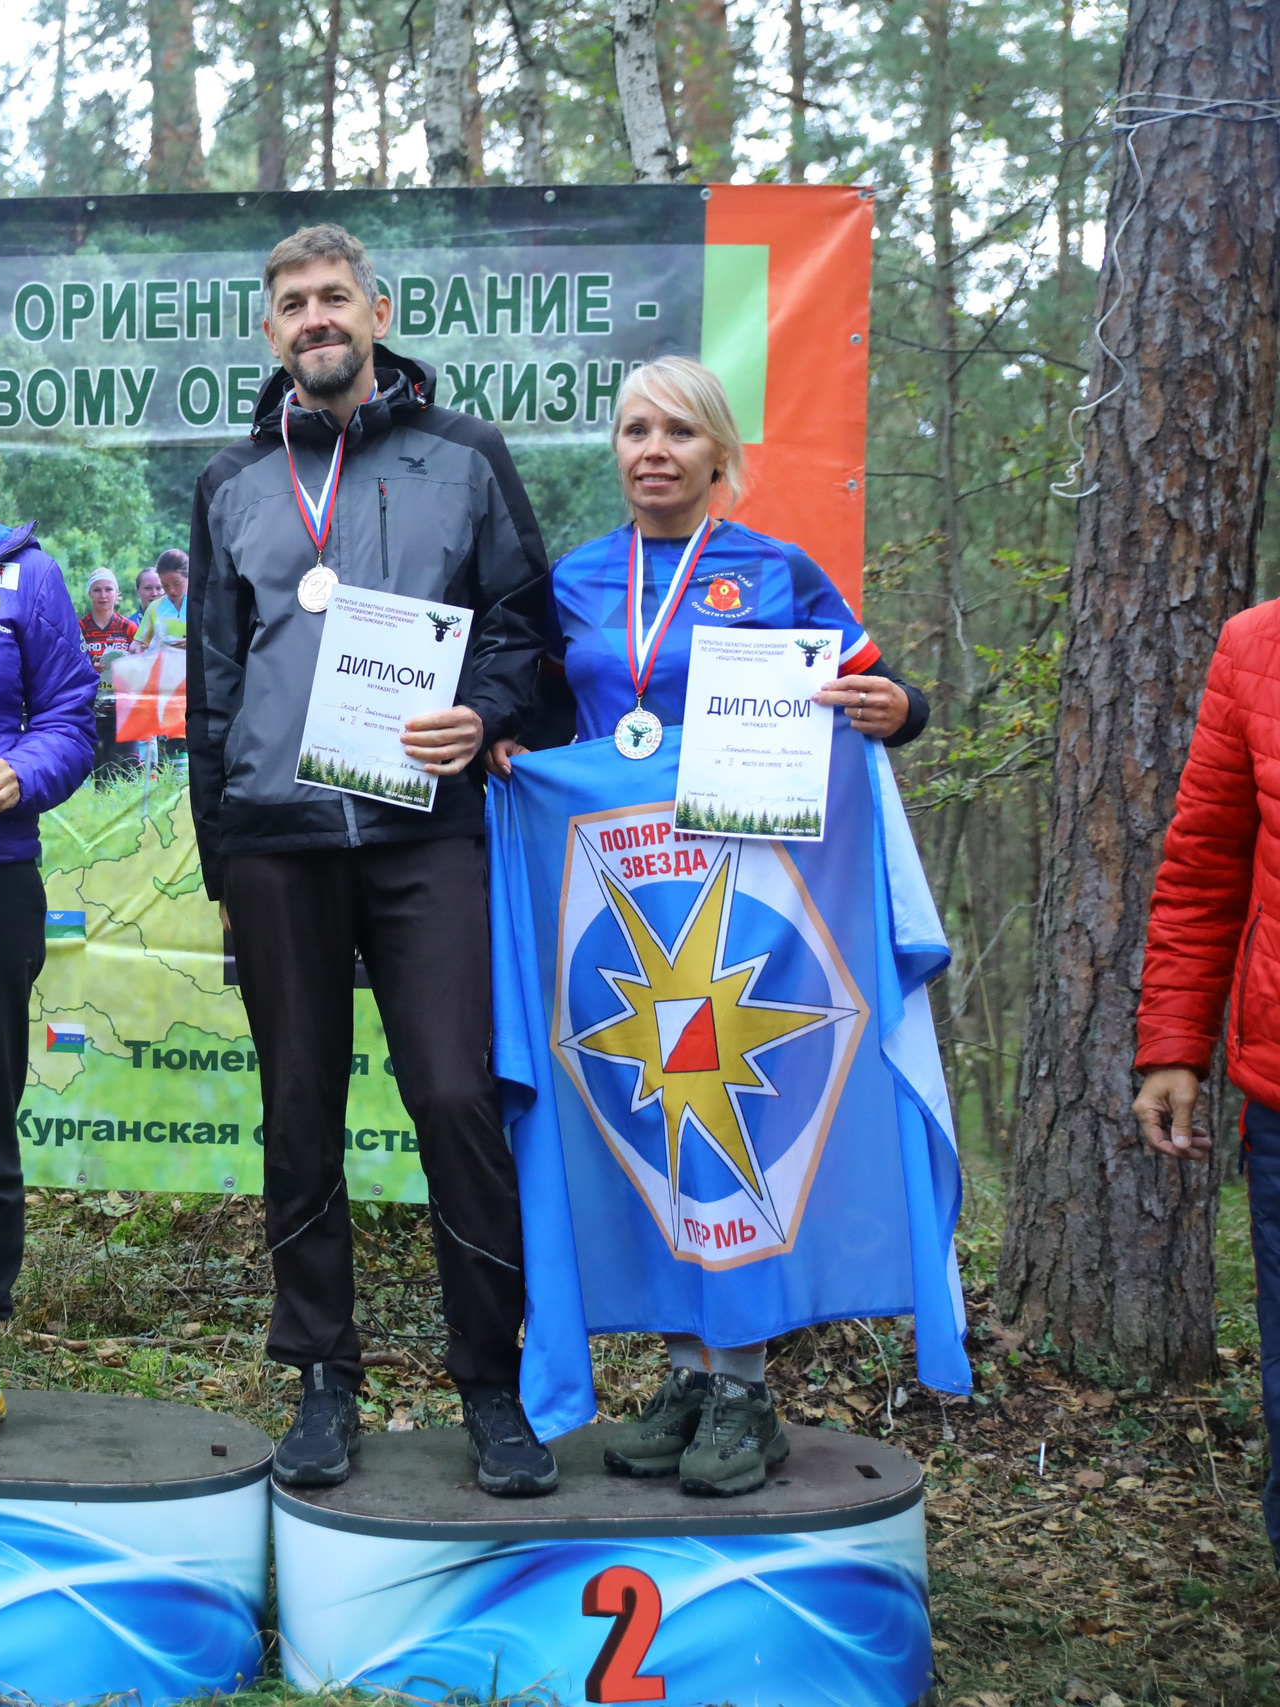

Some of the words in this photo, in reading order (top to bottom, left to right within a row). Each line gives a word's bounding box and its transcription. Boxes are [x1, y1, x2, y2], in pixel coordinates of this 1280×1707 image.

[15, 273, 612, 342] ОРИЕНТВАНИЕ
[443, 361, 642, 424] ЖИЗН
[336, 654, 435, 690] ДИПЛОМ
[707, 696, 811, 718] ДИПЛОМ
[599, 822, 714, 853] ПОЛЯР
[620, 847, 709, 880] ЗВЕЗДА
[15, 1108, 240, 1147] Курганская
[683, 1216, 757, 1250] ПЕРМЬ
[581, 1564, 666, 1704] 2
